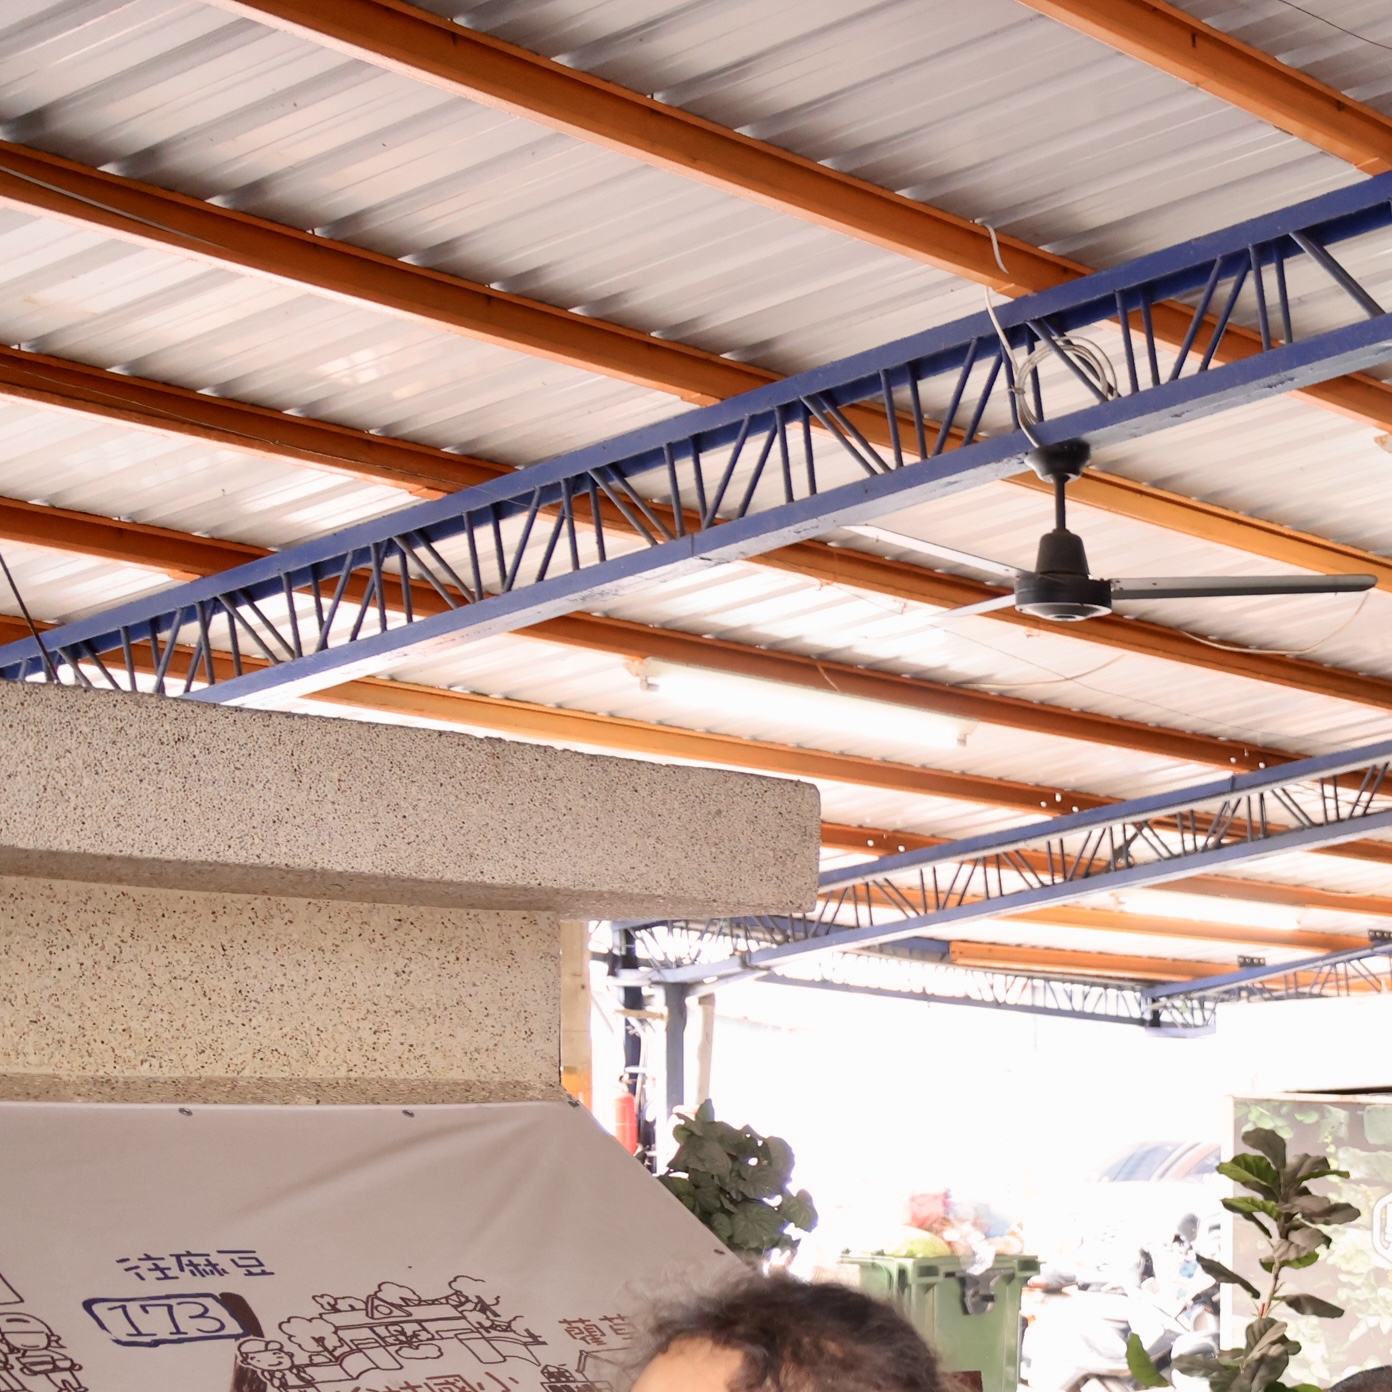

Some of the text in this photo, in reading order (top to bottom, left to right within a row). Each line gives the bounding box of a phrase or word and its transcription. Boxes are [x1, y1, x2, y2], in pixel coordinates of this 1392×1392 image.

[116, 1250, 275, 1281] 往麻豆
[107, 1302, 226, 1336] 173
